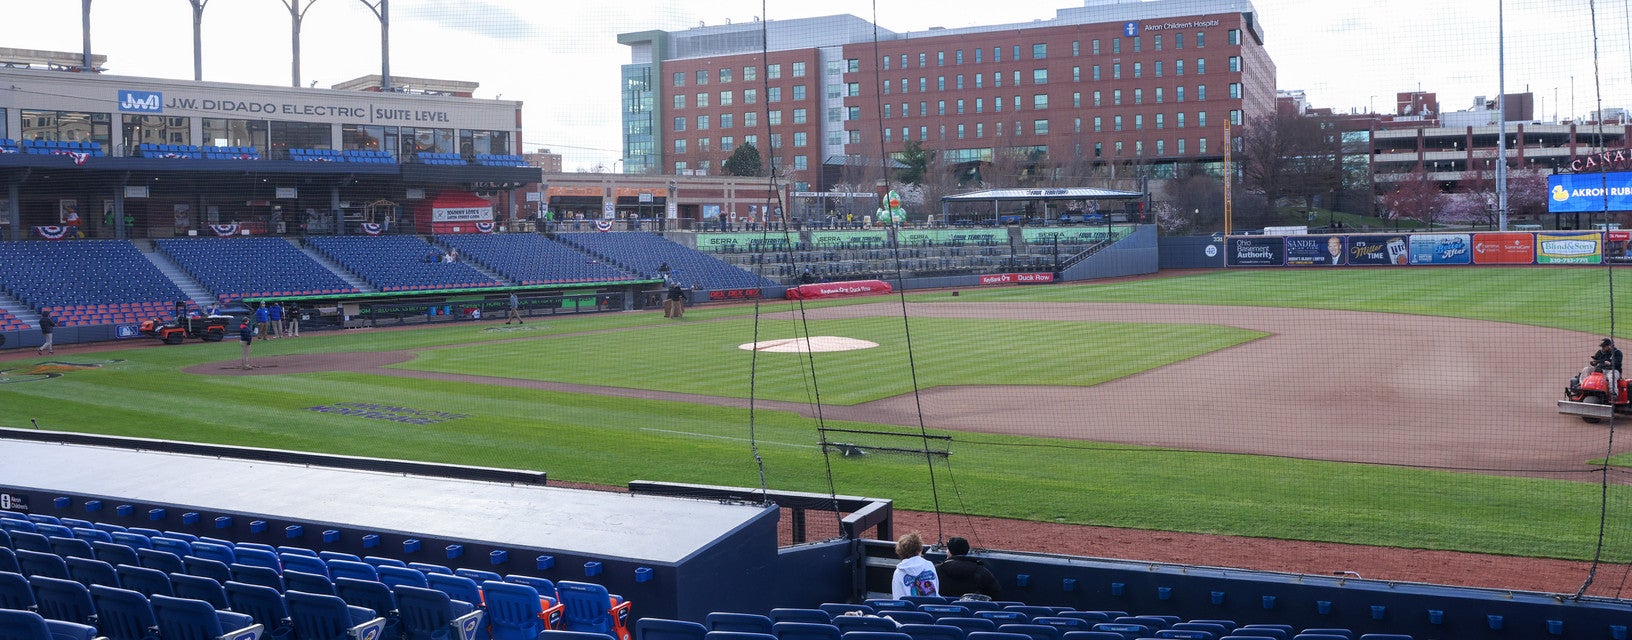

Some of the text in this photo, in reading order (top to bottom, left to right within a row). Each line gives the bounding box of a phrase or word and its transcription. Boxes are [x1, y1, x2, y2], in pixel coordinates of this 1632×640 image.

[1194, 20, 1219, 28] Hospital
[165, 97, 365, 118] J.W. DIDADO ELECTRIC
[376, 108, 450, 122] SUITE LEVEL
[1571, 149, 1632, 171] CANA
[1571, 187, 1632, 197] AKRON RUB
[1206, 246, 1216, 255] 42
[1350, 244, 1383, 259] Miller
[1435, 243, 1465, 254] Better
[1442, 248, 1466, 259] After
[1236, 251, 1274, 259] Authority
